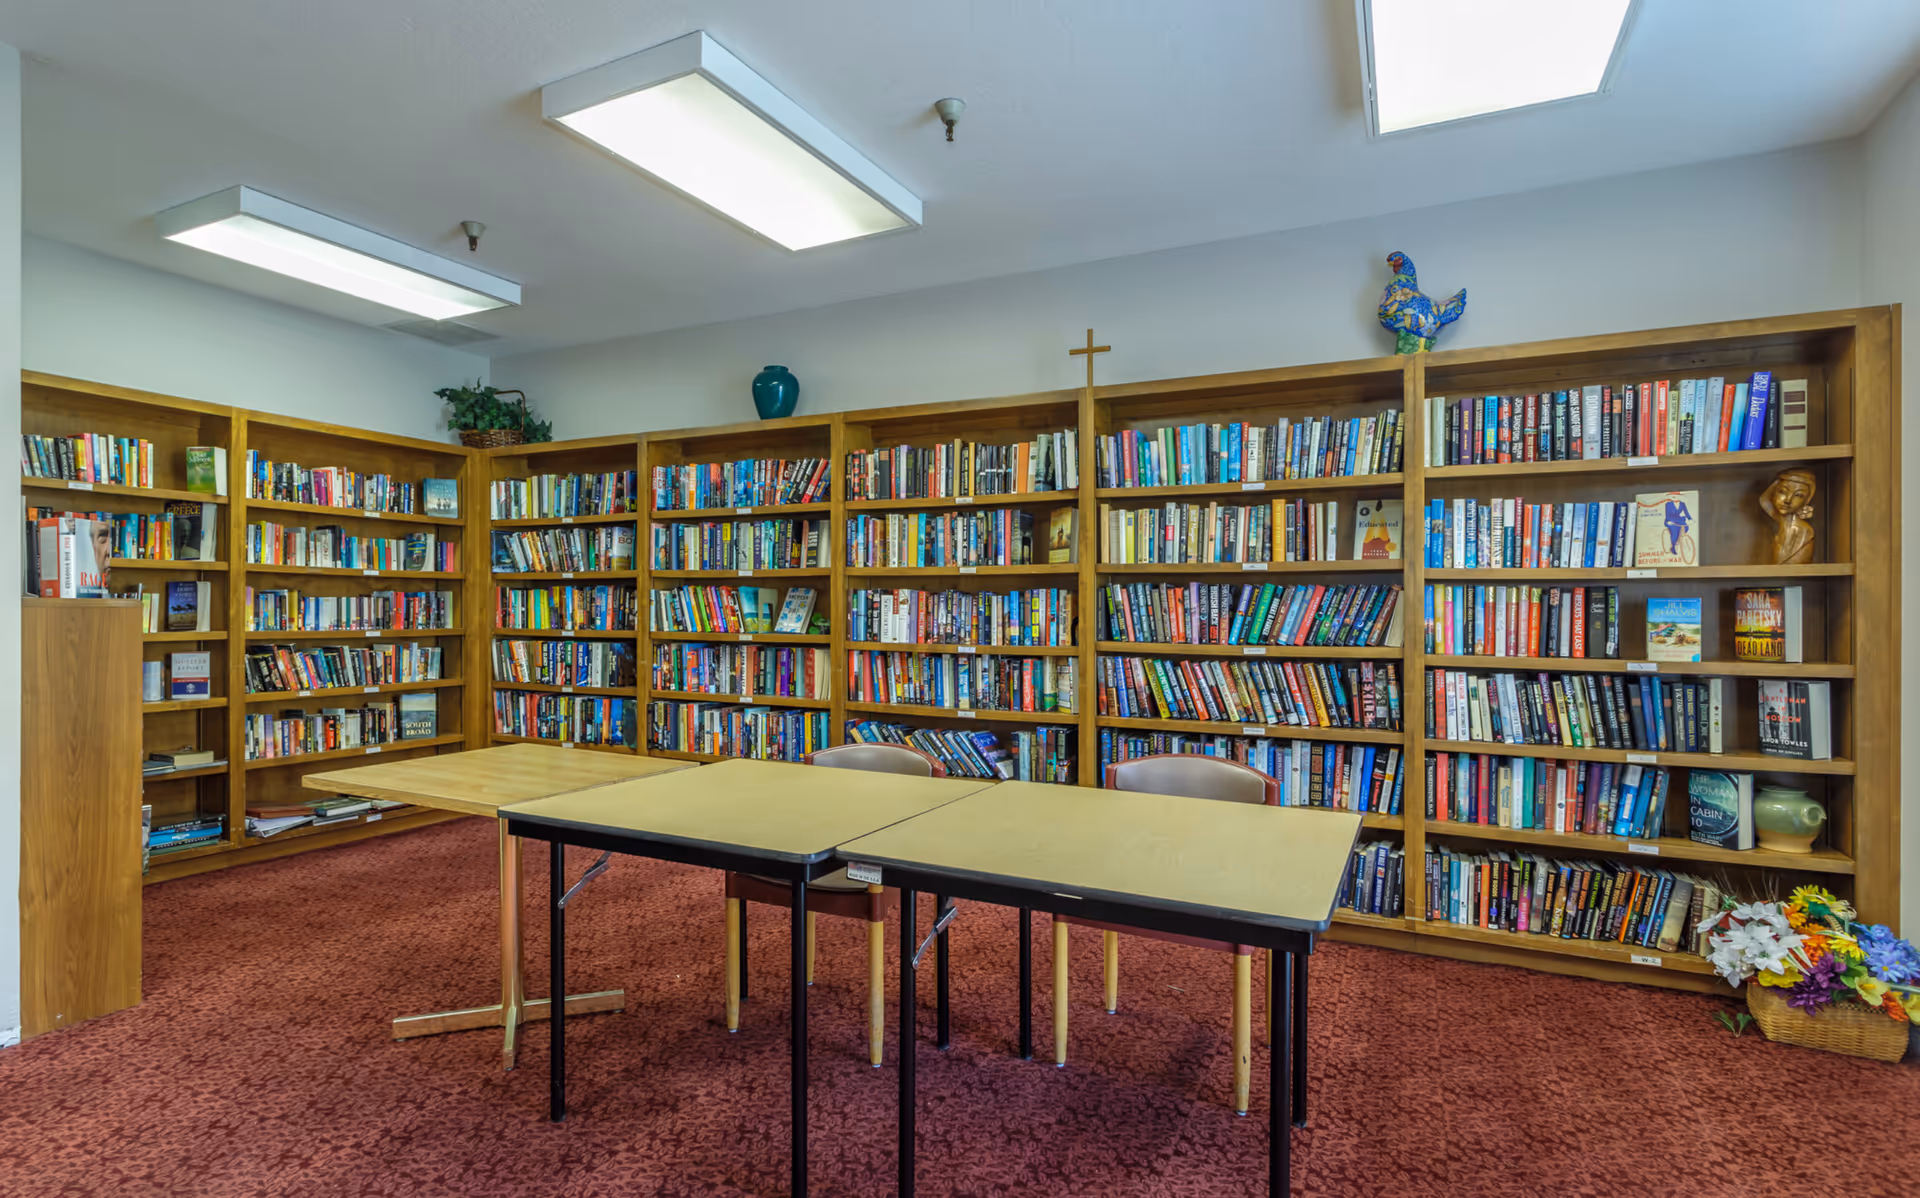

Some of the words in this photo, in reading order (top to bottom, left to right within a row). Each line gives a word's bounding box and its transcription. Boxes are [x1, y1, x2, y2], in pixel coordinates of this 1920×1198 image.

[1514, 398, 1523, 414] JOHN
[1569, 390, 1579, 406] JOHN
[1513, 415, 1522, 441] SANDFORD
[1570, 407, 1581, 437] SANDFORD
[1359, 520, 1399, 528] Educated
[80, 571, 108, 587] RAGE
[1210, 586, 1218, 608] BRUSH
[1747, 592, 1770, 609] SARA
[1268, 598, 1280, 616] ROBERT
[1737, 610, 1782, 627] PARETSKY
[1263, 620, 1274, 636] PARKER
[1737, 640, 1757, 656] DEAD
[1760, 640, 1783, 656] LAND
[1364, 681, 1374, 717] EXILE
[1760, 696, 1806, 704] GENTLEMAN
[1765, 714, 1802, 723] MOSCOW
[406, 728, 431, 736] BROAD
[1690, 773, 1711, 783] THE
[1690, 785, 1734, 800] WOMAN
[1690, 795, 1700, 805] IN
[1690, 806, 1723, 820] CABIN
[1691, 817, 1703, 827] 10
[1648, 877, 1658, 896] STUART
[1643, 897, 1654, 916] WOODS
